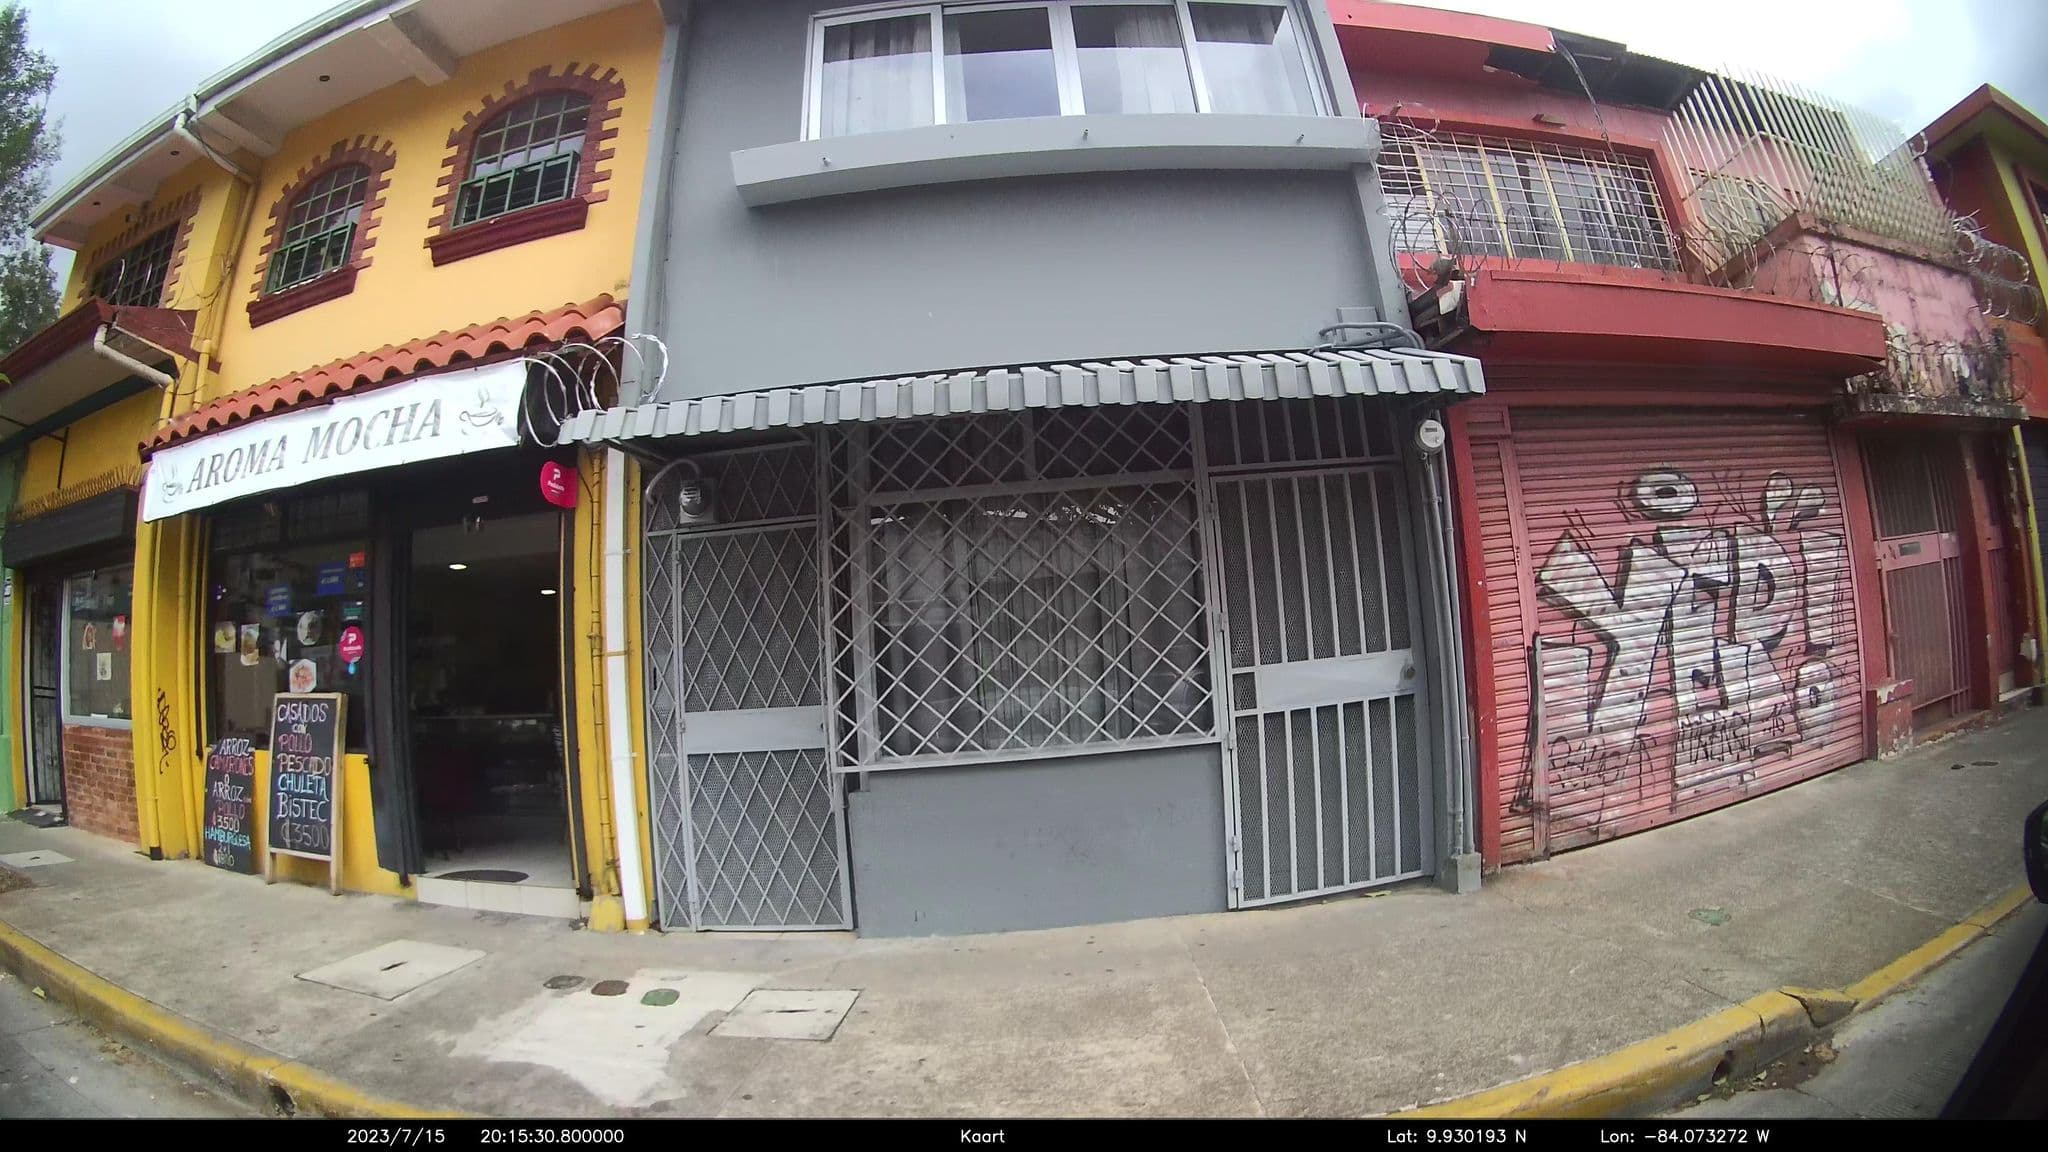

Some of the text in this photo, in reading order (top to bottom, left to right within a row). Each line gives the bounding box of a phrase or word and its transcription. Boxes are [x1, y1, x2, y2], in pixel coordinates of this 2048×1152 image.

[186, 397, 442, 494] AROMA MOCHA
[277, 701, 329, 724] CASADOS
[219, 737, 250, 757] ARROZ
[278, 733, 313, 754] POLLO
[277, 752, 332, 776] PESCADO
[211, 780, 245, 802] ARROZ
[277, 773, 330, 802] CHULETA
